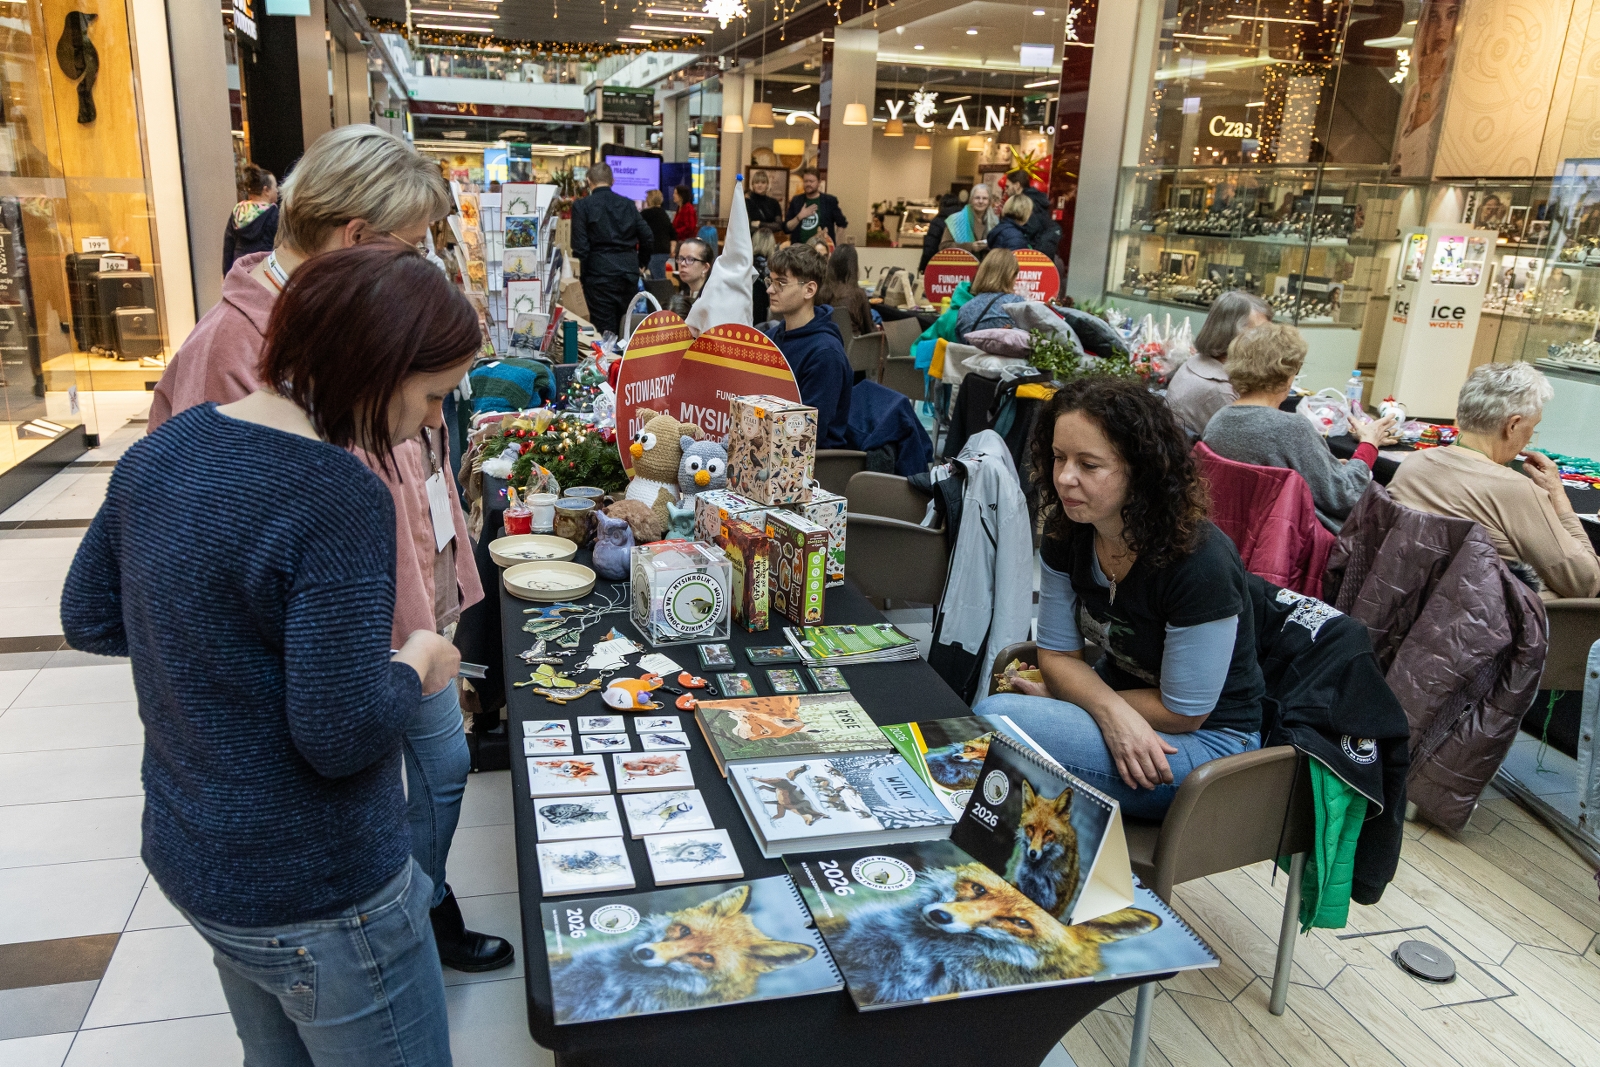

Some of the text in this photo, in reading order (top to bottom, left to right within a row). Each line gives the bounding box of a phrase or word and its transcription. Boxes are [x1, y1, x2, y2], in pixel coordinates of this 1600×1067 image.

[1209, 115, 1253, 138] Czas
[106, 262, 119, 270] 169
[1431, 300, 1466, 320] ice
[1429, 321, 1464, 330] watch
[716, 390, 740, 401] FUND
[673, 574, 711, 590] MYSIKRÓLIK
[666, 586, 722, 632] NA POMOC DZIKIM ZWIERZĘTOM
[834, 709, 861, 730] RYSIE
[889, 727, 909, 742] 2026
[885, 775, 916, 799] WILKI
[971, 802, 999, 827] 2026
[818, 859, 855, 897] 2026
[566, 907, 587, 939] 2026
